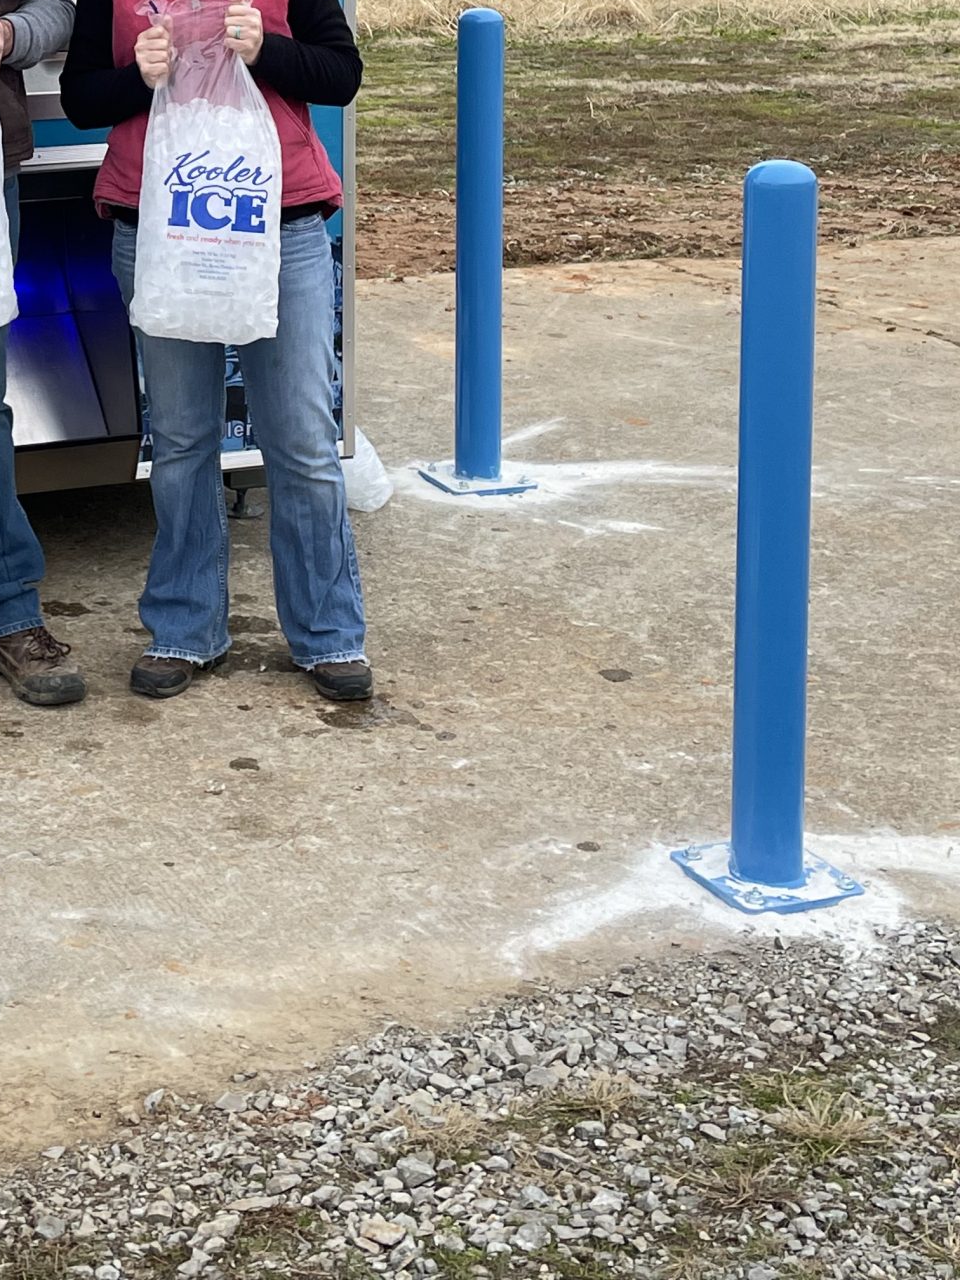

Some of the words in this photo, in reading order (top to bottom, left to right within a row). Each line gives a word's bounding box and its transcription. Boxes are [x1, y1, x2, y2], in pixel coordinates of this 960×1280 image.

[164, 150, 273, 186] Kooler
[167, 183, 268, 234] ICE
[166, 232, 184, 241] fresh
[200, 236, 223, 245] ready
